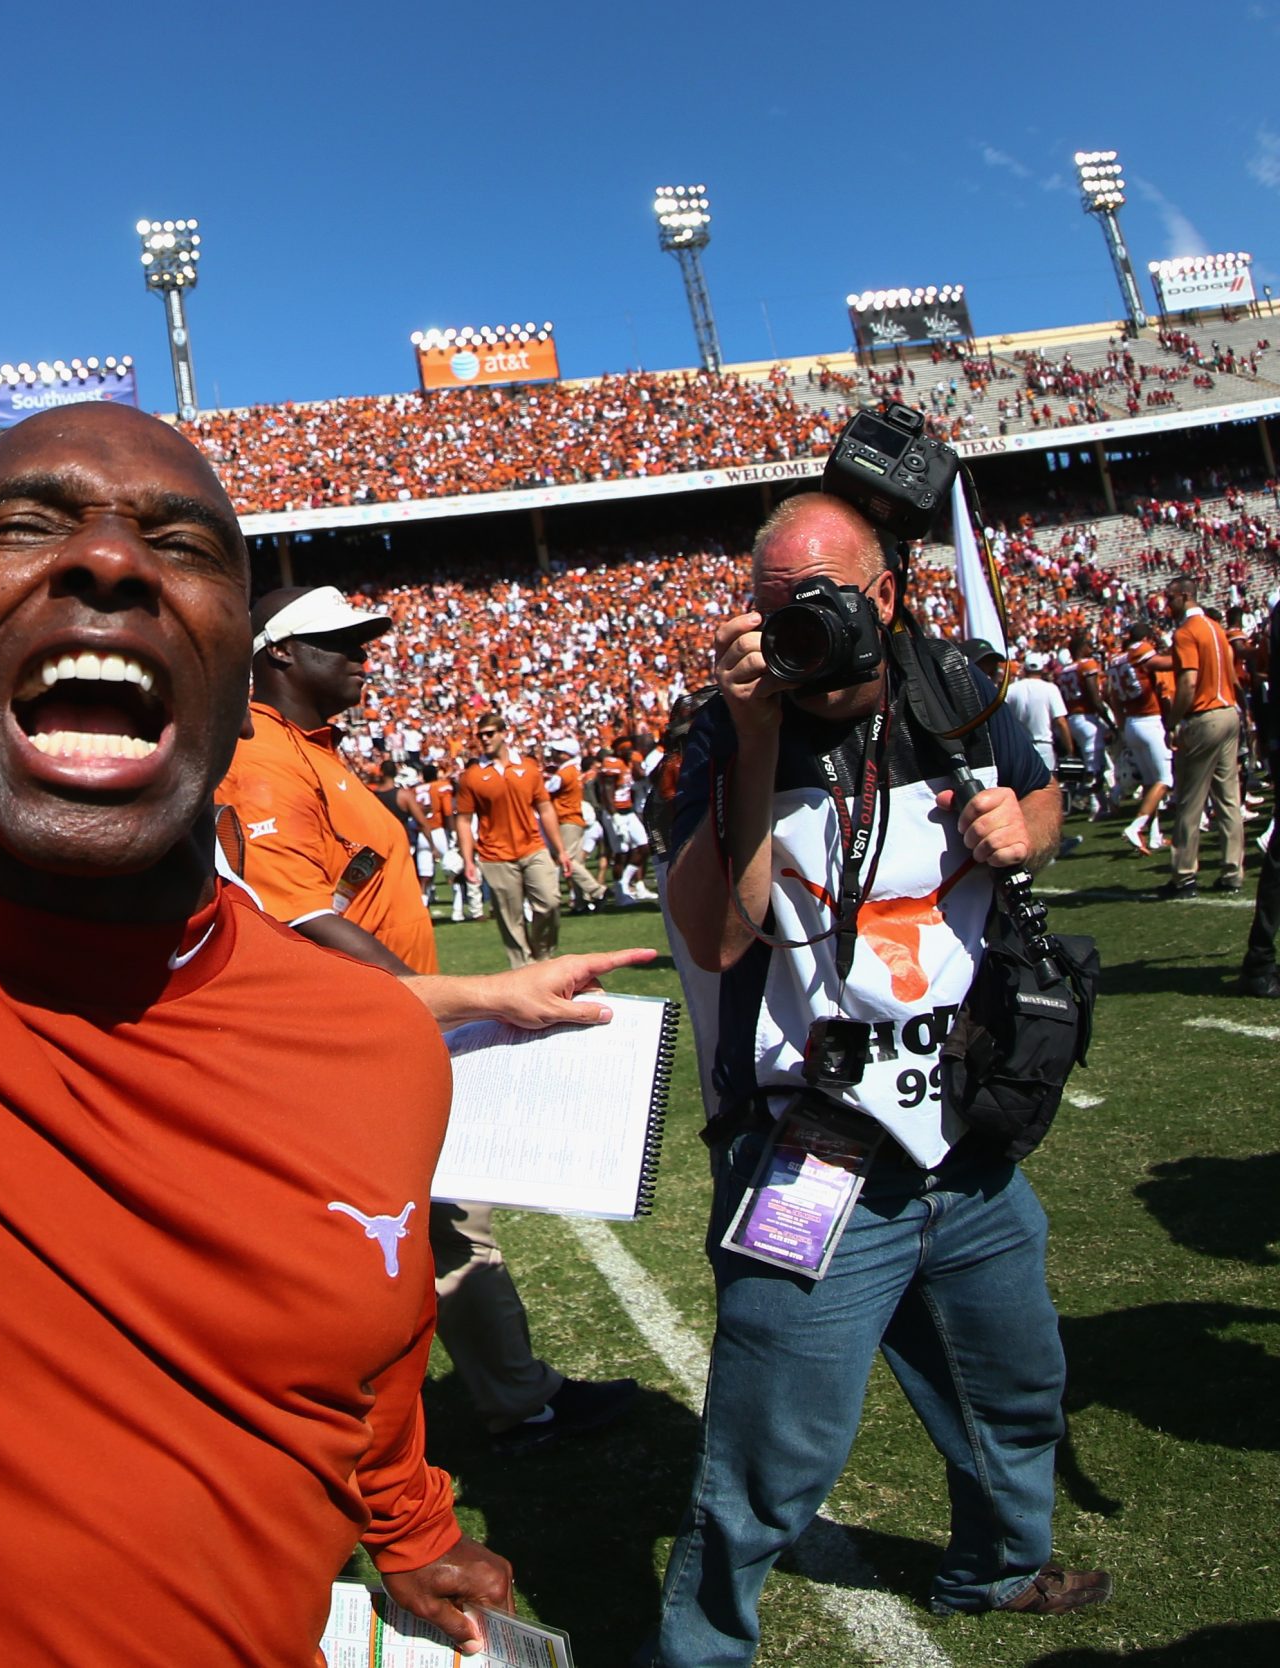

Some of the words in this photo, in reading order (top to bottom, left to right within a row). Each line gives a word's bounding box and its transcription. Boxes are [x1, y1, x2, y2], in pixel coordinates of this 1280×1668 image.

[1167, 281, 1233, 296] DODGE
[484, 350, 531, 373] at&t
[11, 388, 104, 410] Southwest
[726, 462, 811, 483] WELCOME
[961, 440, 1007, 455] TEXAS
[795, 588, 821, 600] Canon
[822, 754, 839, 782] USA
[850, 829, 869, 860] USA
[865, 1003, 959, 1064] HOT
